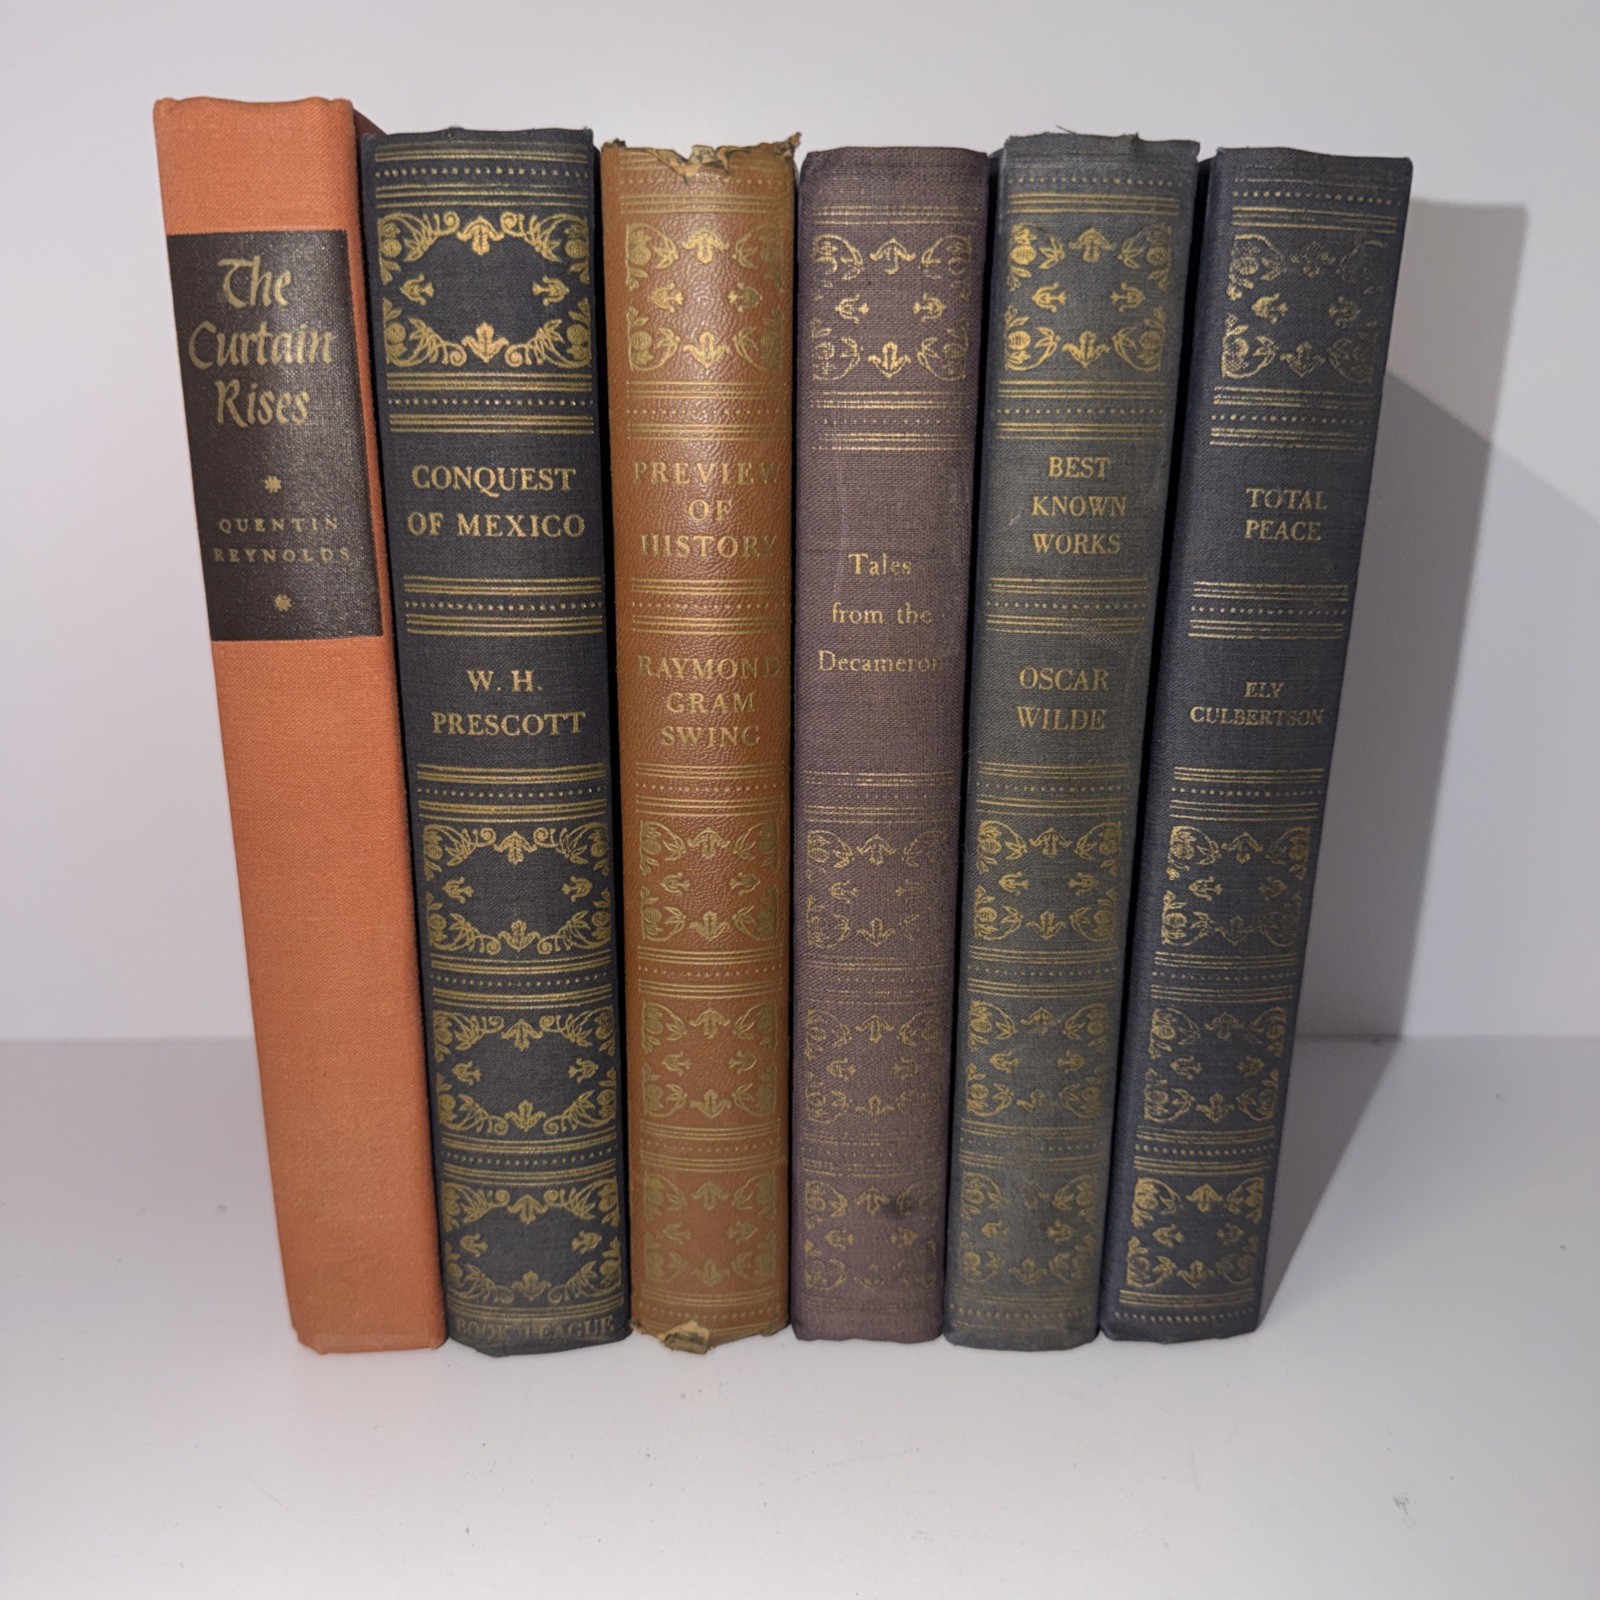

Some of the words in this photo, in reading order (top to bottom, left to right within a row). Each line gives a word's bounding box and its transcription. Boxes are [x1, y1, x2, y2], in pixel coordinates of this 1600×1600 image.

[218, 255, 291, 308] The
[189, 321, 332, 370] Curtain
[214, 379, 310, 428] Rises
[633, 461, 782, 485] PREVIEW
[1048, 456, 1110, 479] BEST
[411, 464, 576, 498] CONQUEST
[688, 499, 733, 523] OF
[1031, 495, 1128, 518] KNOWN
[1245, 487, 1328, 511] TOTAL
[219, 518, 338, 533] QUENTIN
[407, 511, 444, 537] OF
[457, 512, 586, 538] MEXICO
[1243, 518, 1322, 542] PEACE
[213, 547, 350, 563] REYNOLDS
[641, 533, 777, 559] HISTORY
[1032, 532, 1121, 555] WORKS
[848, 552, 912, 576] Tales
[832, 601, 884, 625] from
[897, 601, 932, 625] the
[638, 655, 780, 680] RAYMOND
[817, 650, 944, 673] Decameron
[466, 669, 501, 692] W.
[511, 669, 543, 692] H.
[1018, 666, 1109, 691] OSCAR
[1243, 681, 1285, 699] ELY
[666, 692, 755, 715] GRAM
[431, 711, 586, 737] PRESCOTT
[1017, 705, 1107, 731] WILDE
[1189, 705, 1324, 727] CULBERTSON
[660, 725, 760, 748] SWING
